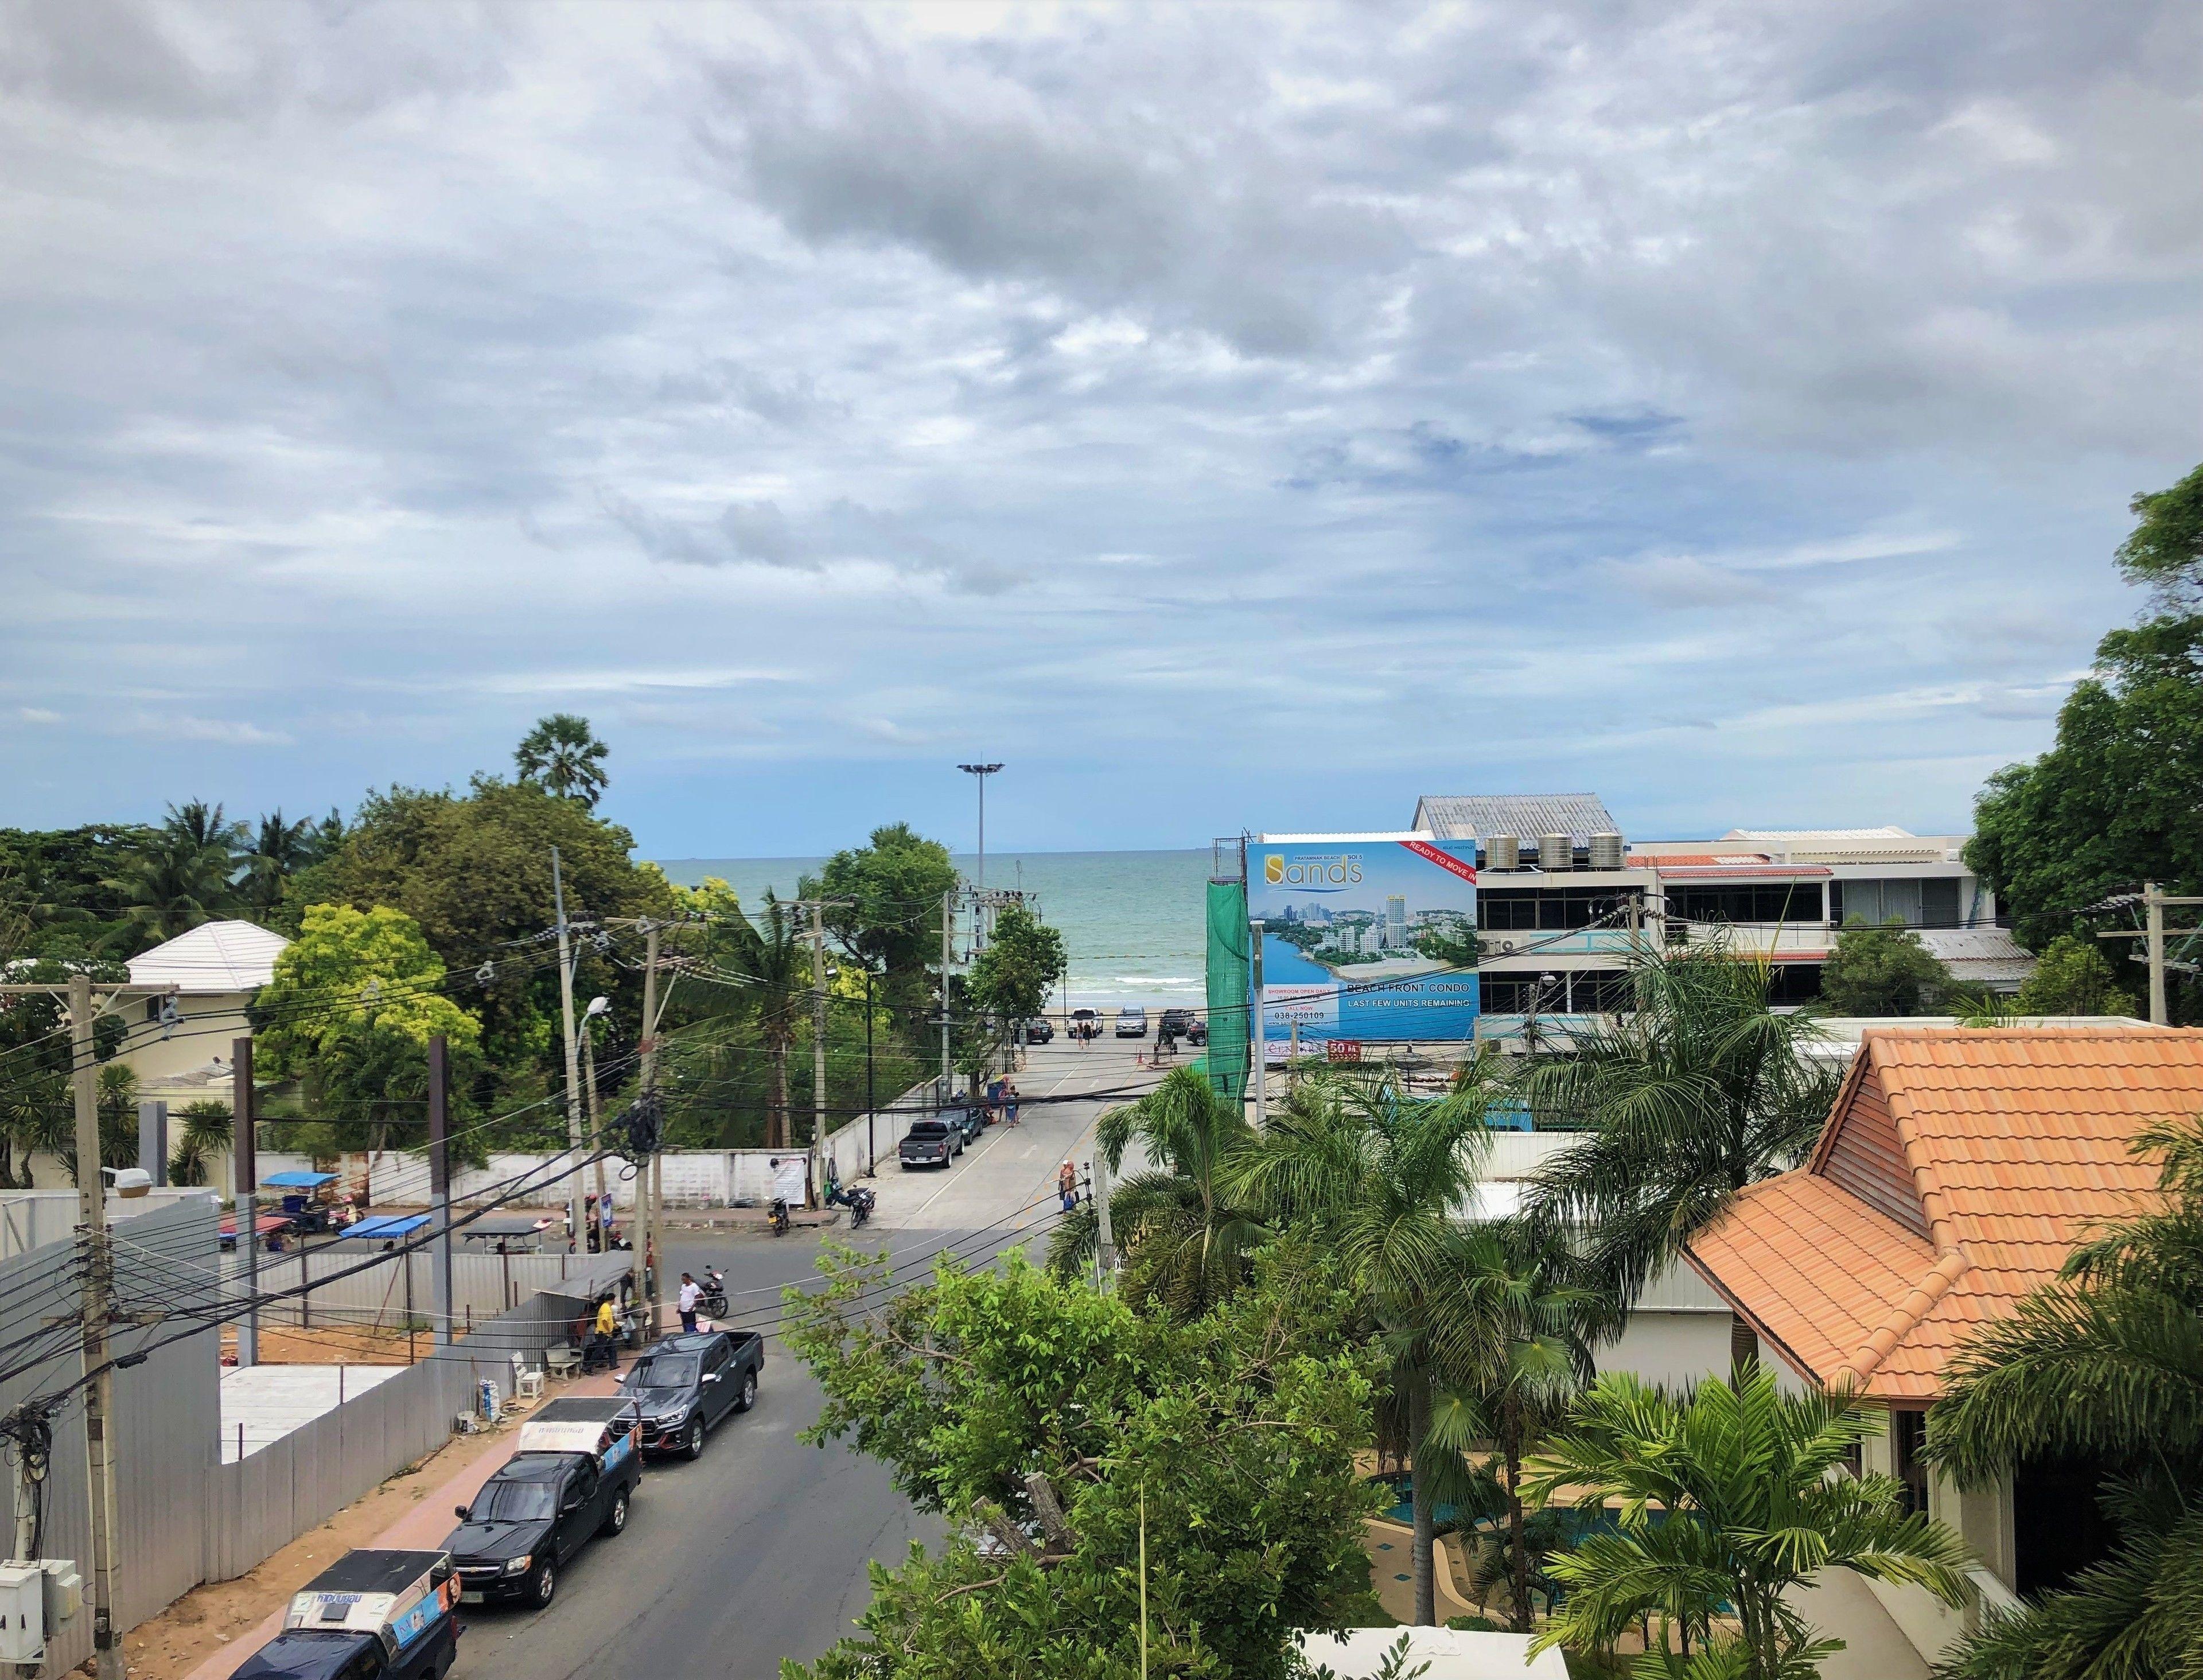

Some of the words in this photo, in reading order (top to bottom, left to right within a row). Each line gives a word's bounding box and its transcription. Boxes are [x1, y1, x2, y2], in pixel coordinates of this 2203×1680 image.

[1266, 855, 1363, 884] Sands
[1409, 841, 1435, 858] READY
[1436, 854, 1446, 864] TO
[1446, 861, 1469, 877] MOVE
[1468, 872, 1477, 881] IN
[1348, 984, 1385, 993] BEACH
[1388, 983, 1426, 993] FRONT
[1429, 983, 1470, 993] CONDO
